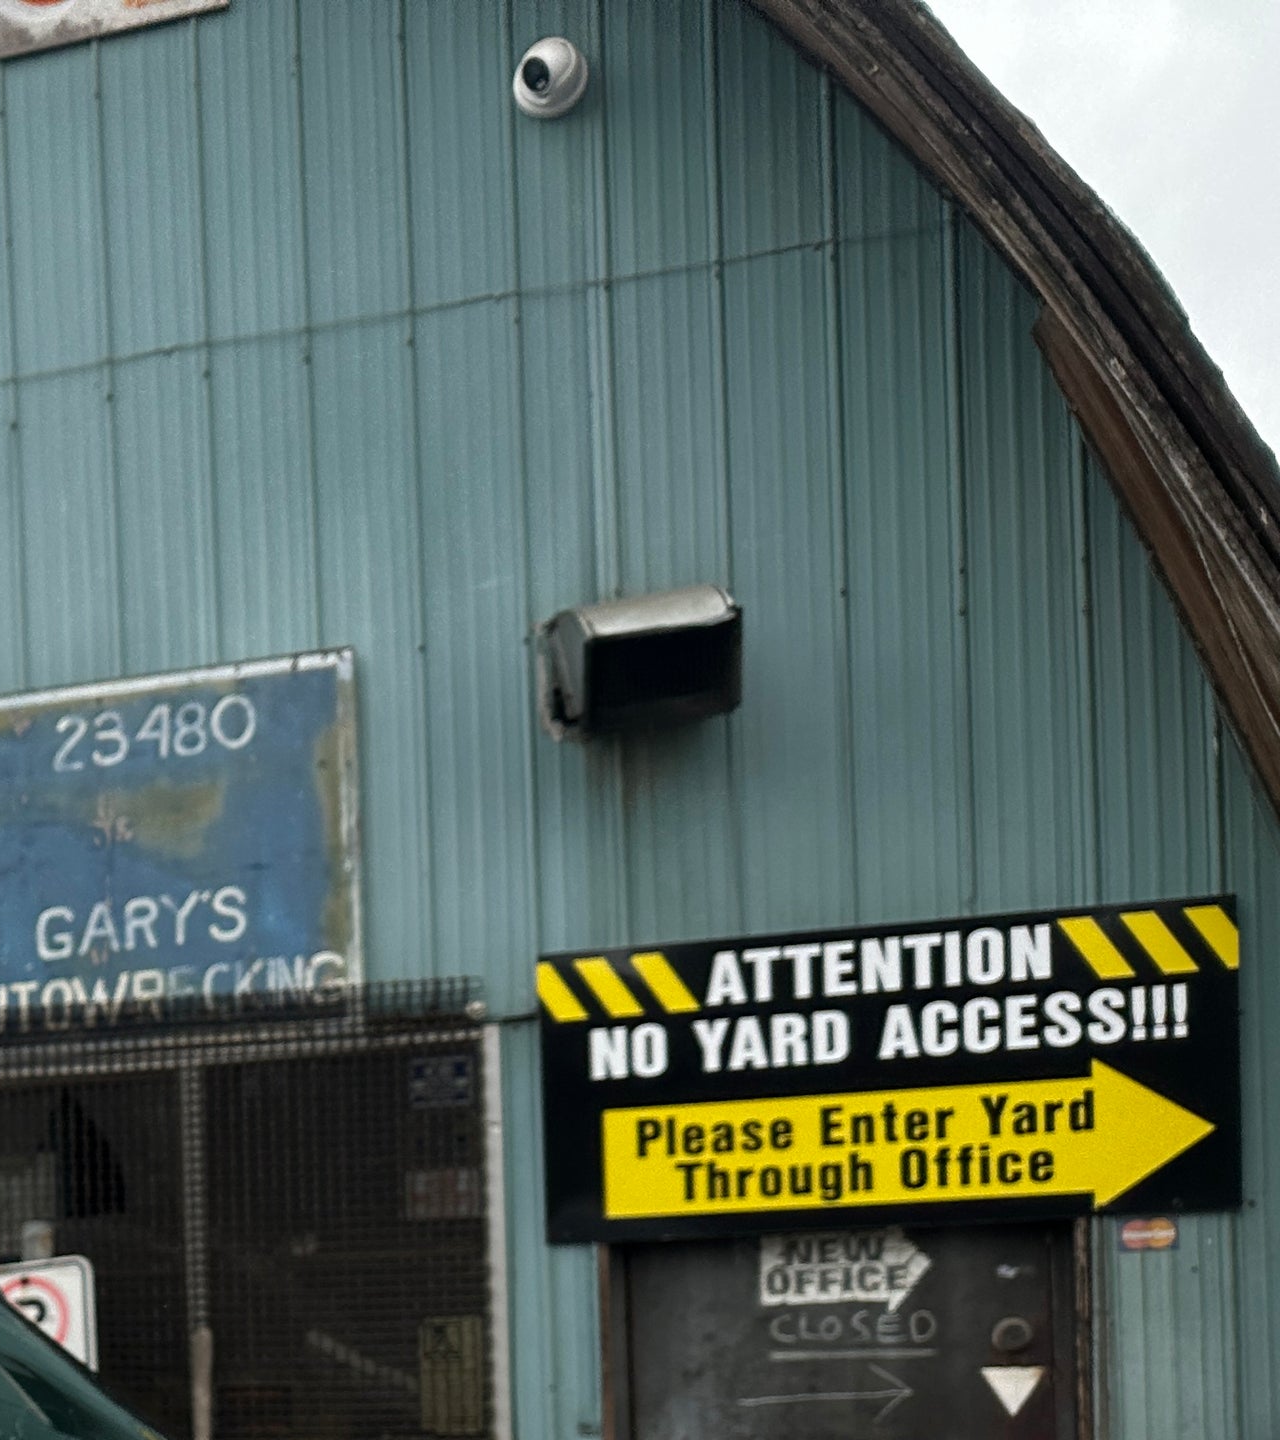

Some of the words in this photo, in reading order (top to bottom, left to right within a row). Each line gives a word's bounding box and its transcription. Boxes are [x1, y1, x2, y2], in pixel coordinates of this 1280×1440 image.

[52, 694, 257, 773] 23480
[36, 886, 247, 961] GARY'S
[706, 924, 1053, 1006] ATTENTION
[589, 1023, 668, 1081] NO
[696, 1009, 850, 1073] YARD
[878, 983, 1190, 1061] ACCESS!!!
[635, 1113, 794, 1159] Please
[819, 1102, 955, 1145] Enter
[980, 1089, 1096, 1134] Yard
[675, 1155, 874, 1203] Through
[900, 1145, 1056, 1189] Office
[766, 1264, 908, 1296] OFFICE
[783, 1233, 884, 1264] NEW
[769, 1308, 937, 1344] CLOSED
